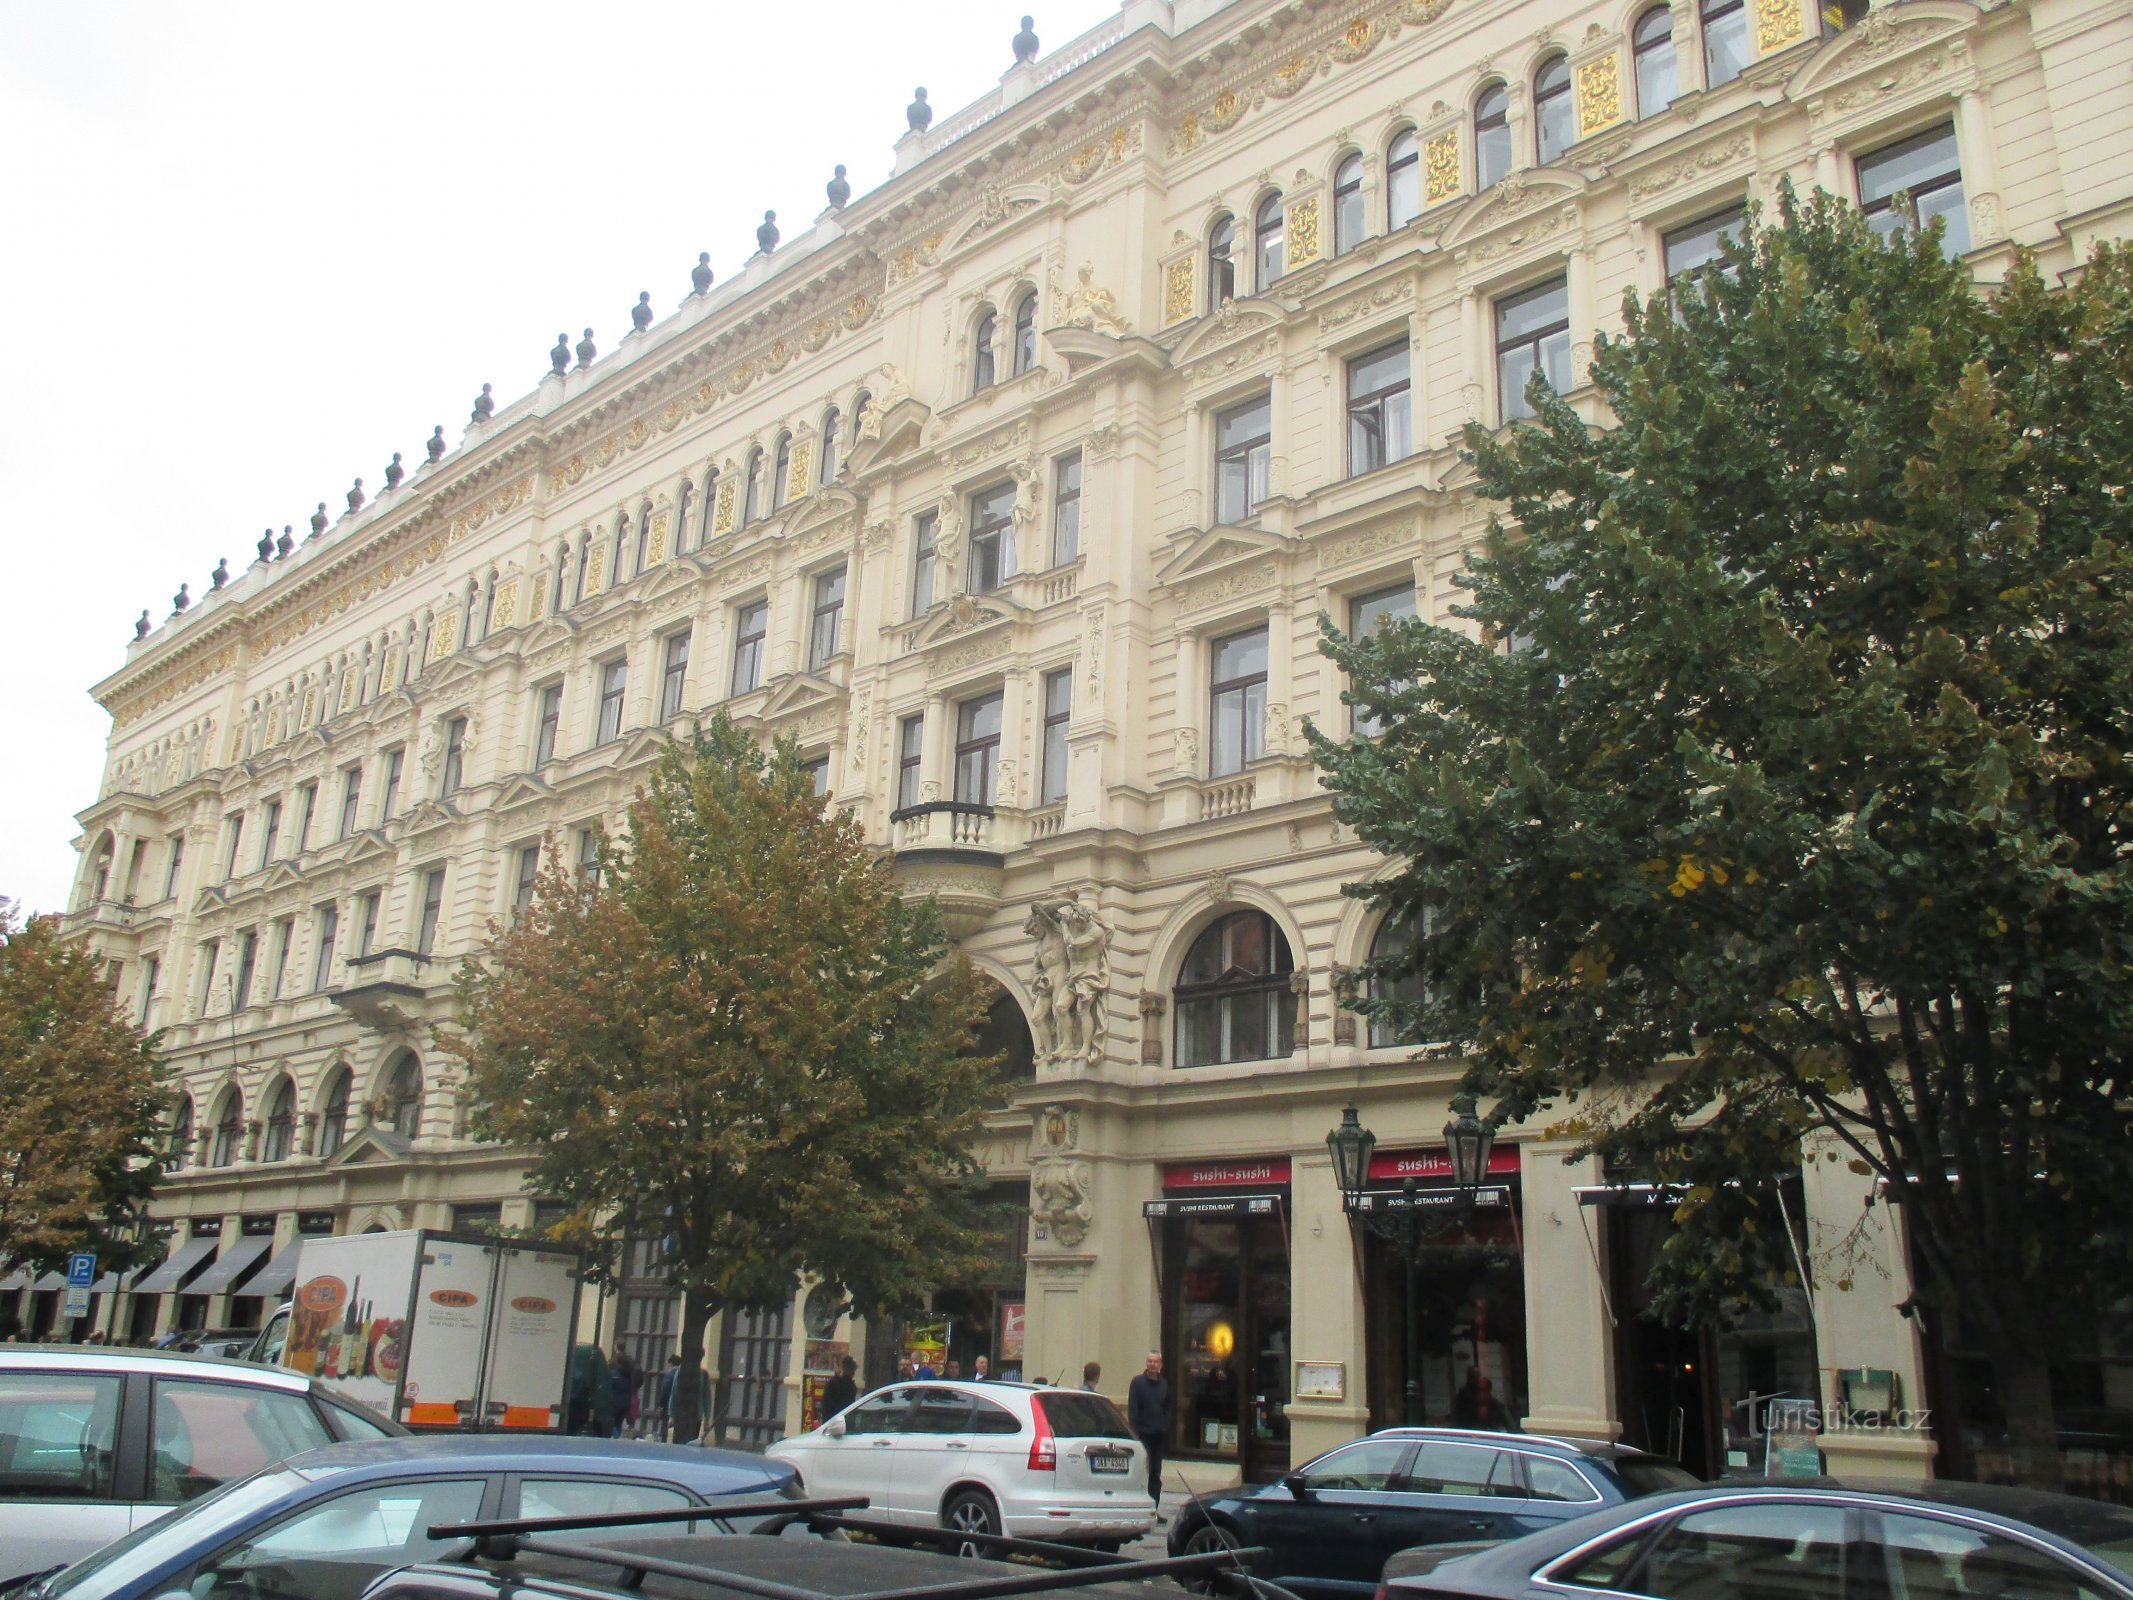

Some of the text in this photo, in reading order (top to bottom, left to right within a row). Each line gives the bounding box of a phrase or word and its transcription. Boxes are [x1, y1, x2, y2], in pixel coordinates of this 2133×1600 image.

[1180, 1203, 1236, 1212] SUSHI RESTAURANT
[74, 1258, 90, 1276] P
[309, 1286, 337, 1302] CIPA
[439, 1293, 468, 1304] CIPA
[519, 1299, 547, 1310] CIPA
